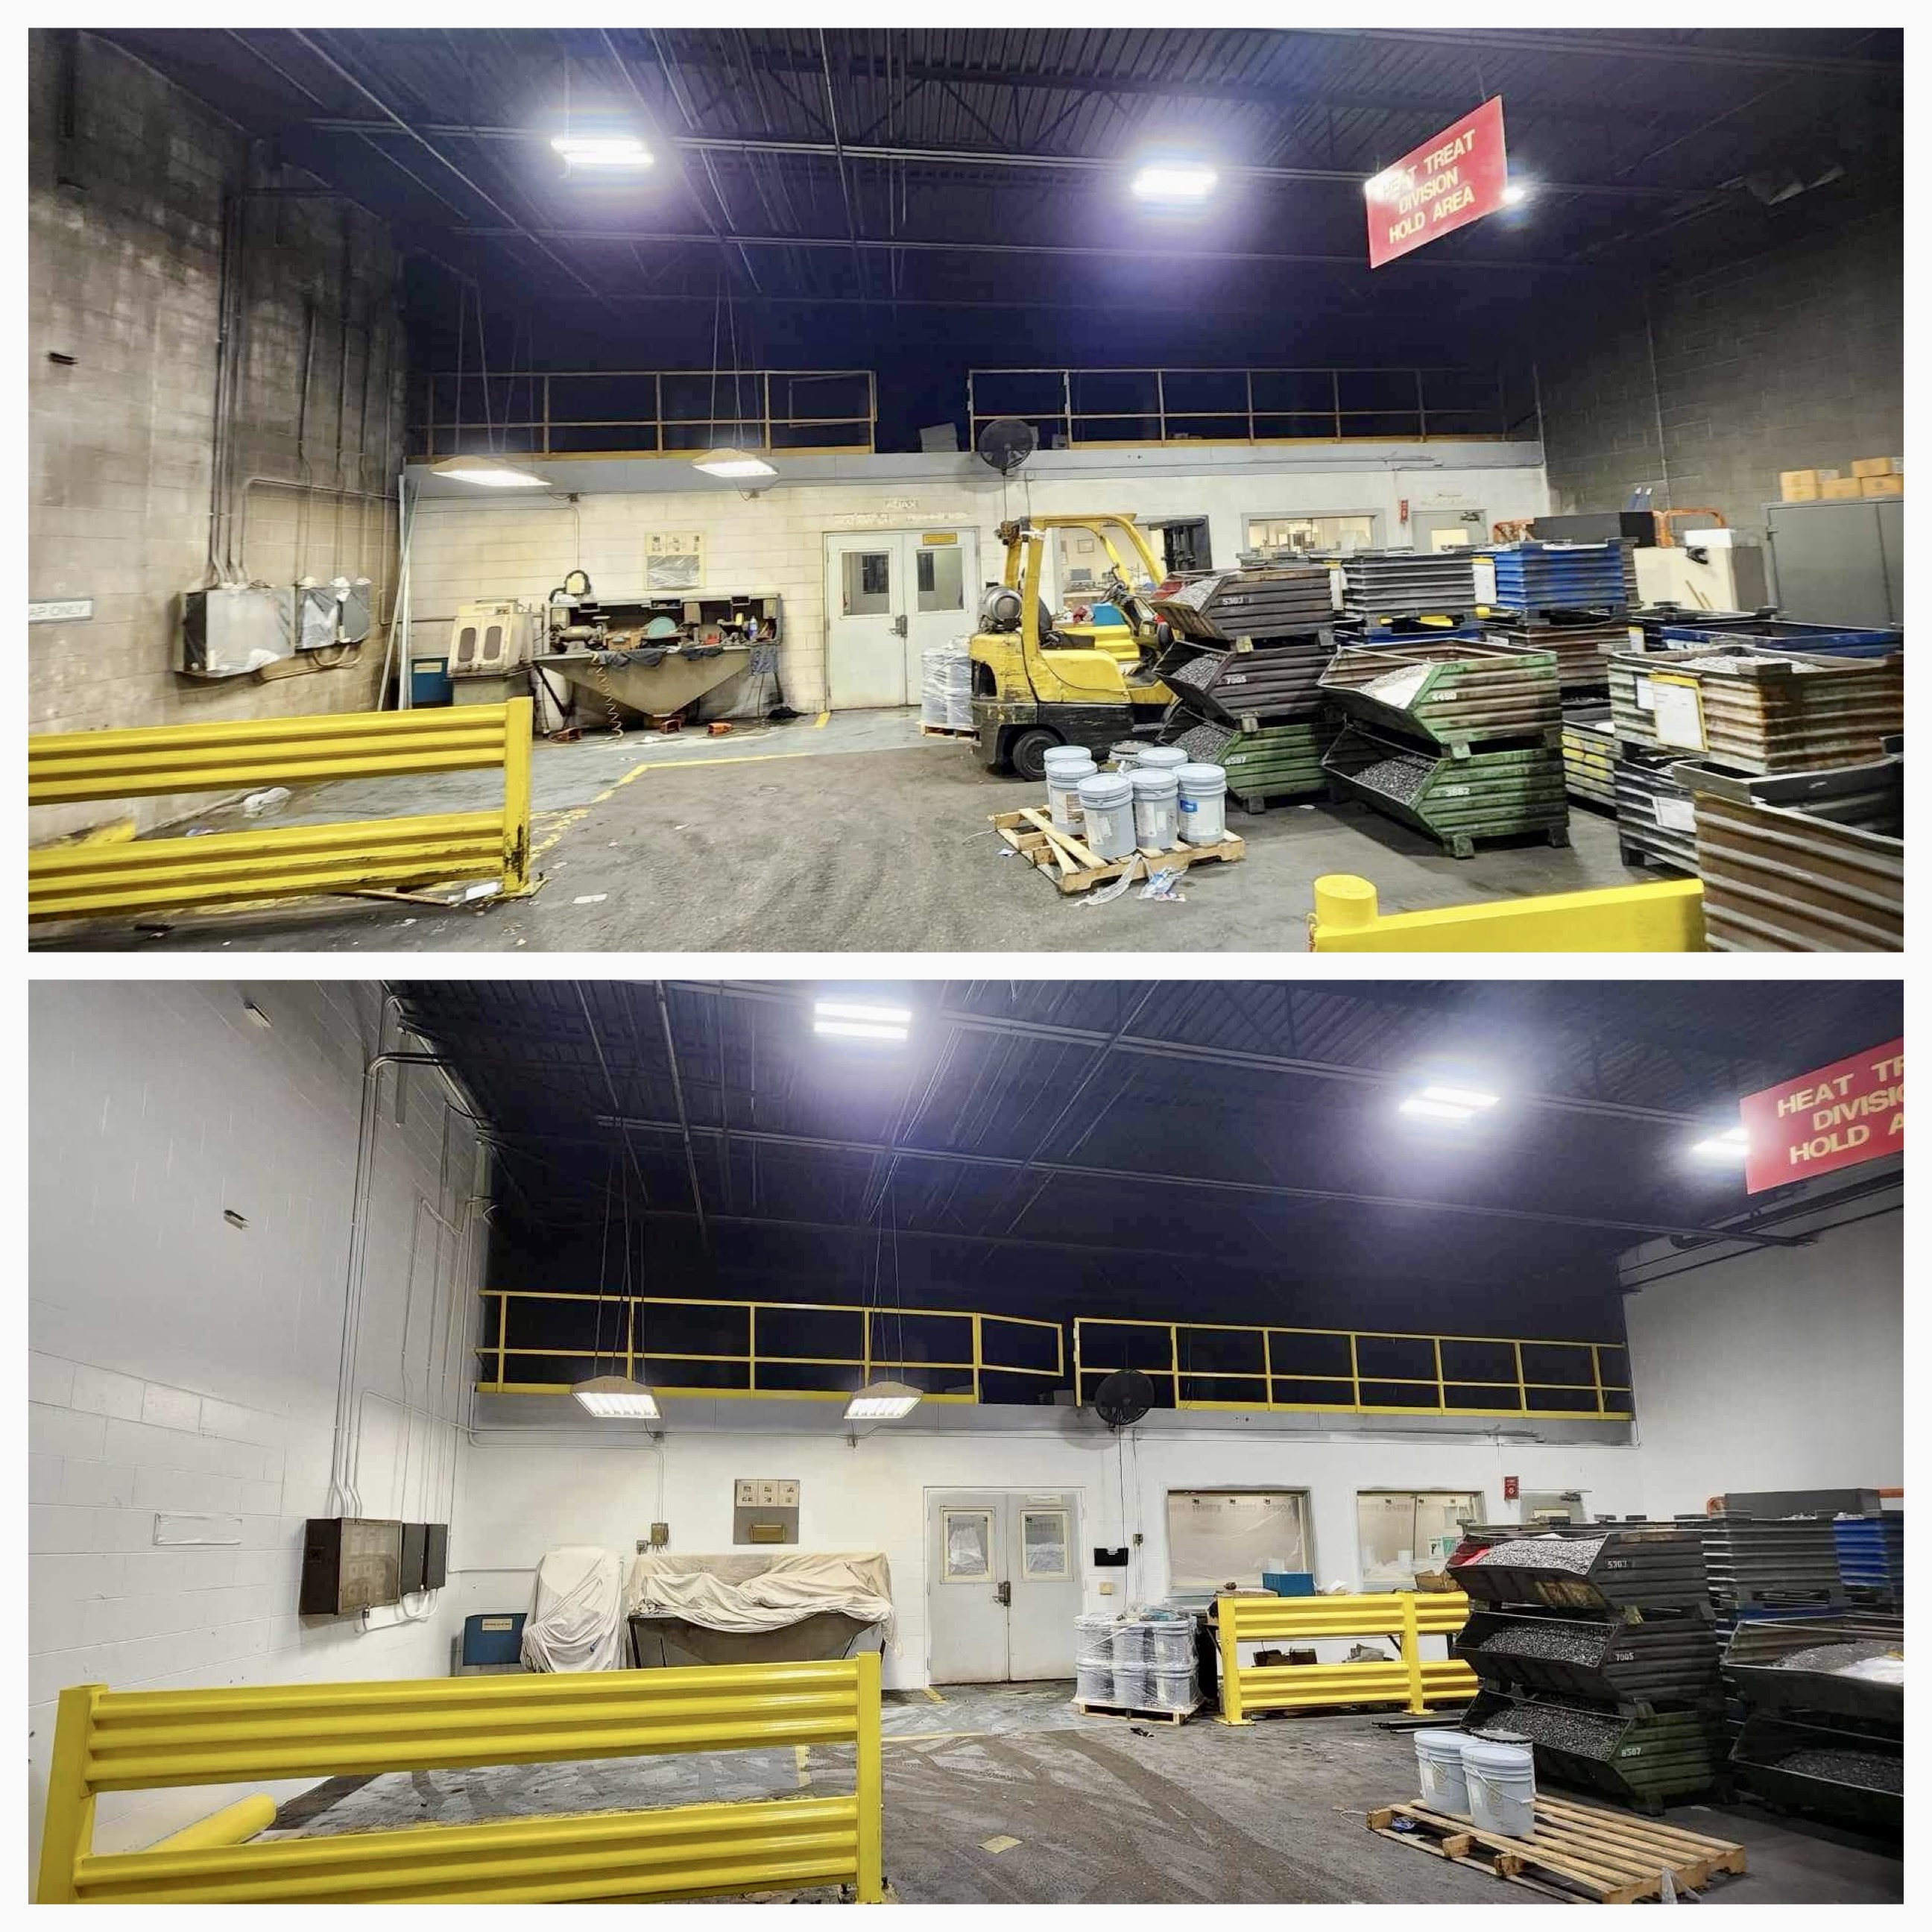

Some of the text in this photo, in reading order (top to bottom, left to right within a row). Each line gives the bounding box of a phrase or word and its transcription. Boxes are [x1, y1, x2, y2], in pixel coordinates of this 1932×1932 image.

[1380, 129, 1475, 201] EAT TREAT
[1389, 186, 1475, 244] HOLD AREA
[1398, 166, 1459, 215] DIVISION
[1777, 1073, 1854, 1118] HEAT
[1790, 1125, 1870, 1165] HOLD
